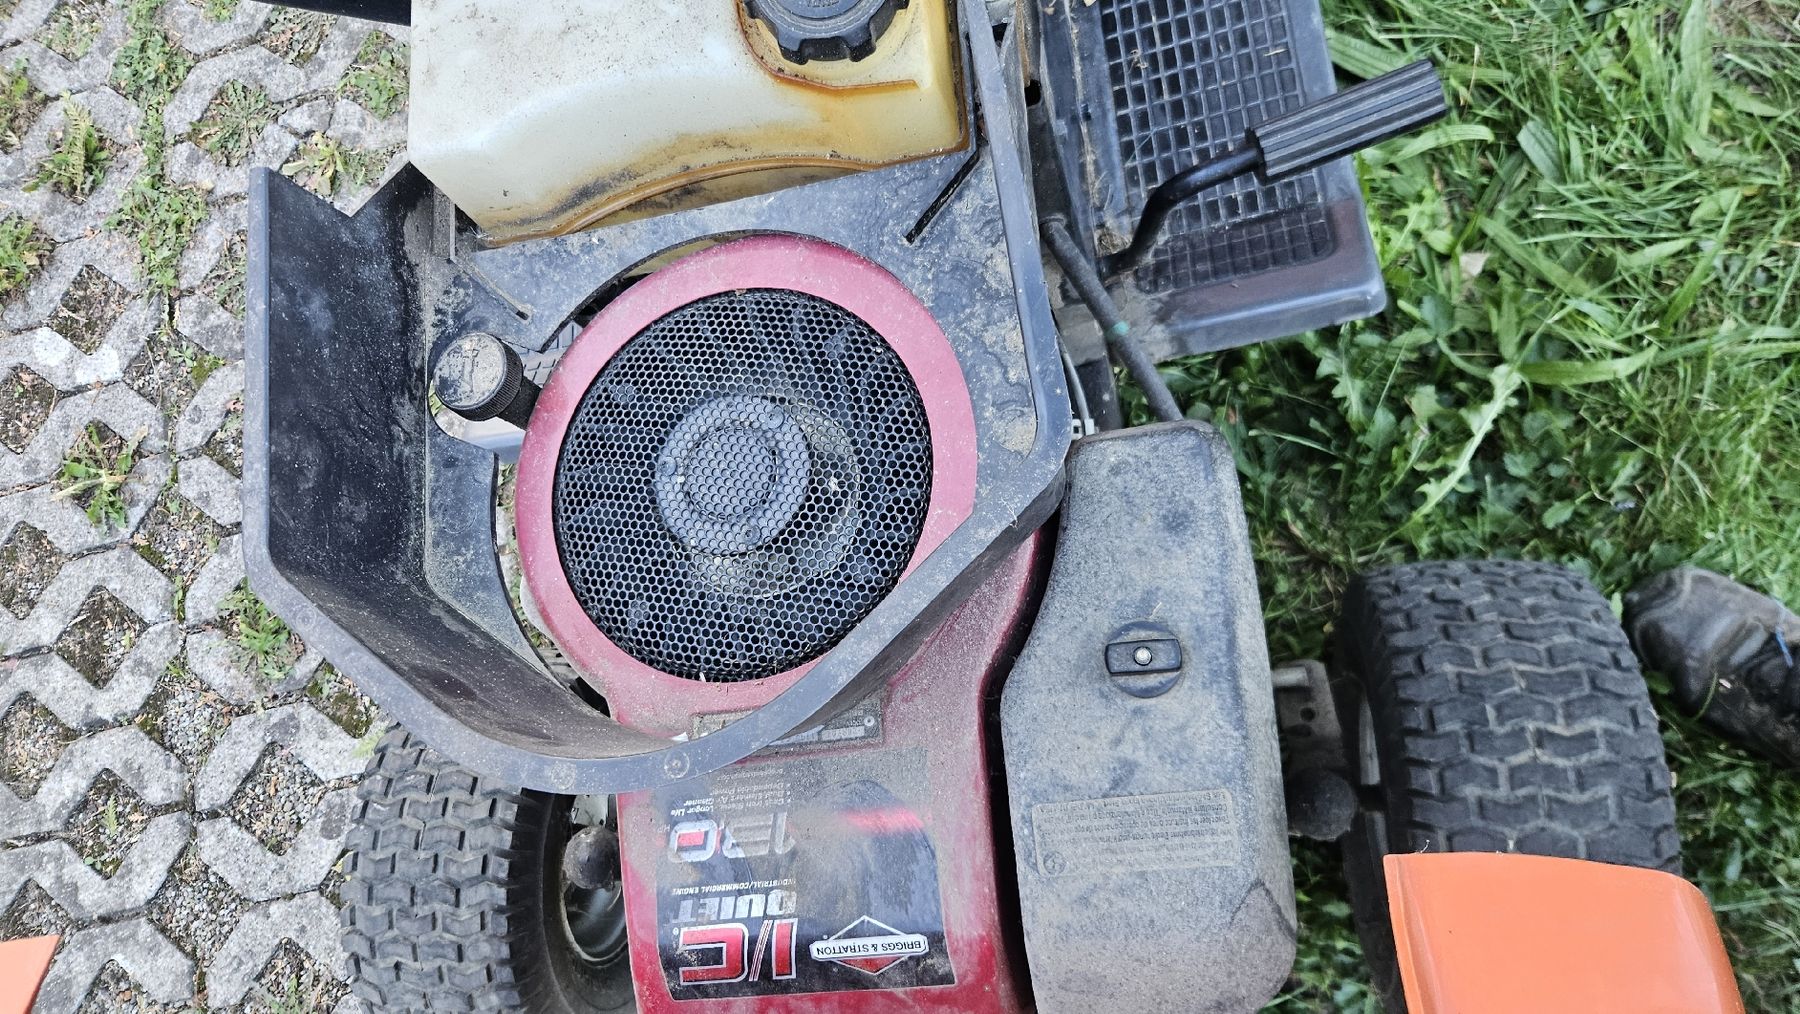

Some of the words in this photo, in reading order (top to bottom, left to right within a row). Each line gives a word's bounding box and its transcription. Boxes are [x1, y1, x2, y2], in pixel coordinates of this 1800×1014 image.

[683, 797, 714, 807] Cleaner
[670, 808, 685, 817] Life
[686, 805, 714, 815] Longer
[671, 889, 797, 923] QUIET
[816, 943, 870, 956] STRATTON
[870, 943, 878, 952] &
[881, 940, 922, 951] BRIGGS
